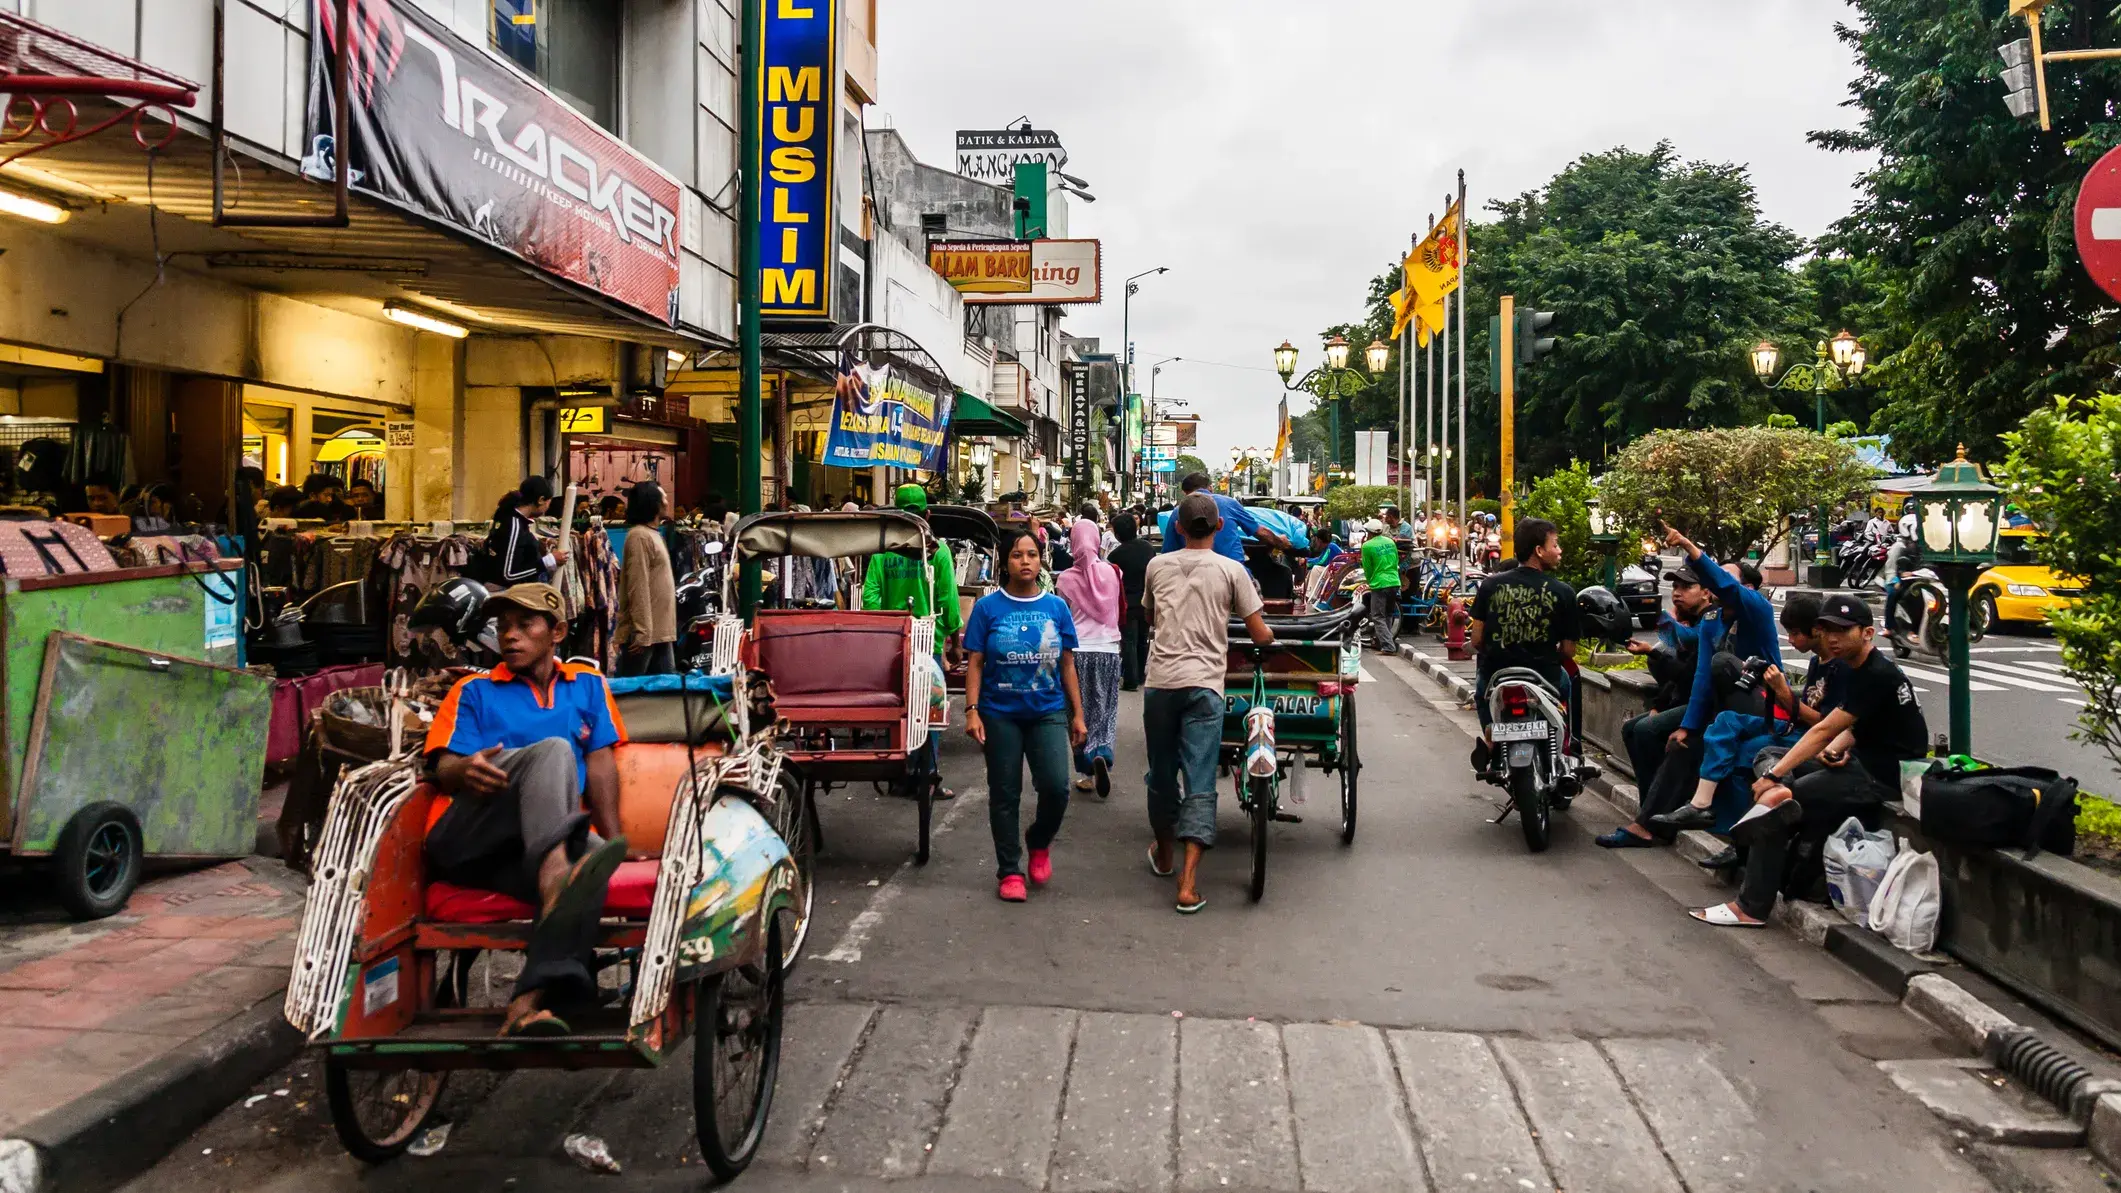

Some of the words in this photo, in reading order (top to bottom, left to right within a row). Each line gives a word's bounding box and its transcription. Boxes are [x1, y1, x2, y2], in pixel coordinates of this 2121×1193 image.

[403, 20, 676, 258] TRACKER
[958, 136, 994, 145] BATIK
[996, 136, 1005, 144] &
[1008, 135, 1056, 145] KABAYA
[762, 66, 820, 304] MUSLIM
[547, 191, 572, 209] KEEP
[574, 206, 611, 233] MOVING
[947, 243, 966, 252] Sepeda
[1011, 243, 1030, 252] Sepeda
[933, 255, 979, 278] ALAM
[984, 255, 1030, 279] BARU
[1074, 372, 1086, 417] KEBAYA
[1075, 418, 1085, 427] &
[1073, 429, 1086, 481] MODISTE
[1273, 695, 1322, 715] ALAP
